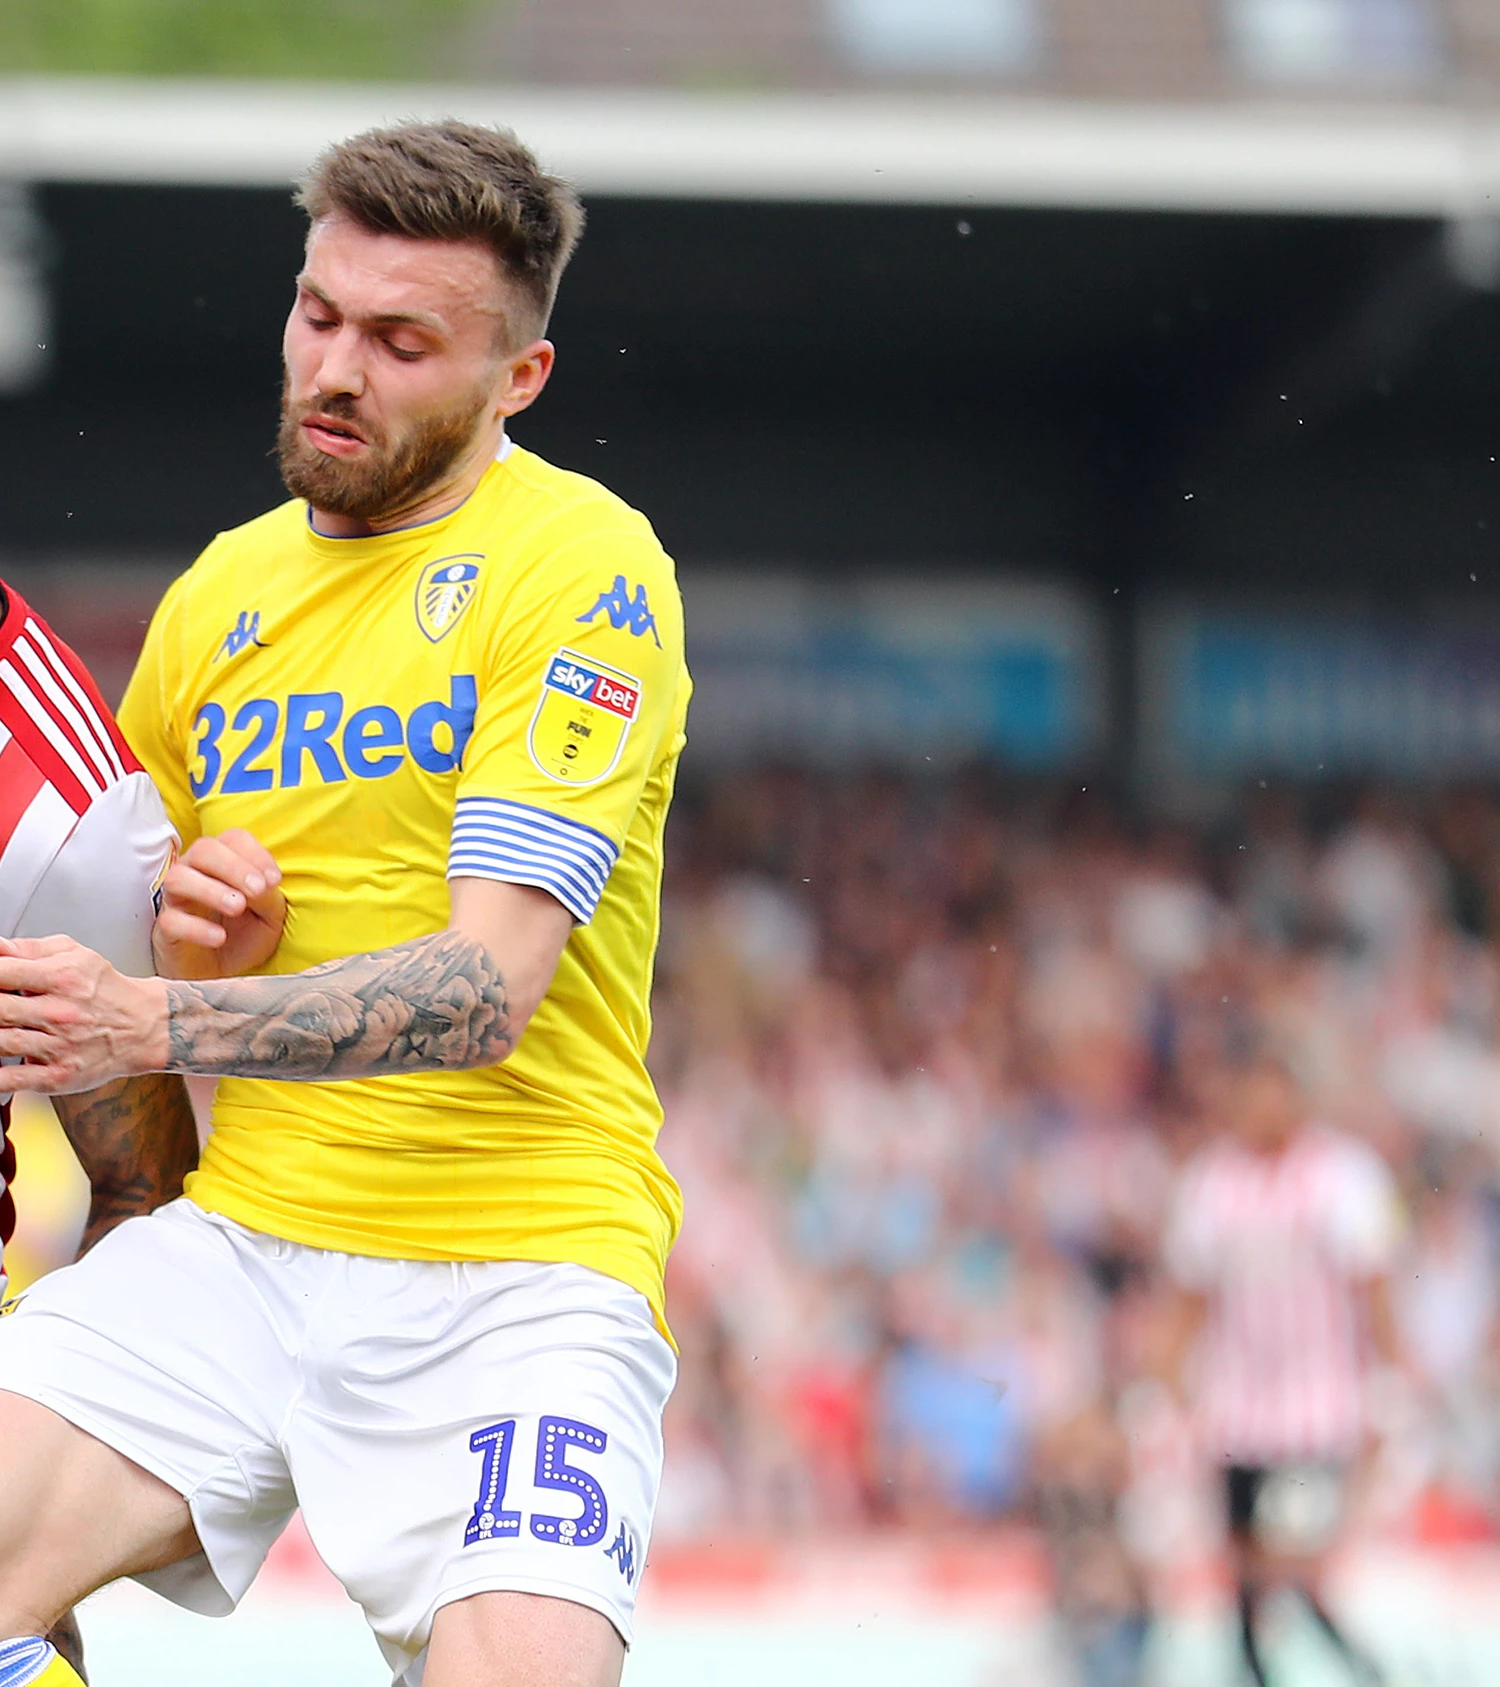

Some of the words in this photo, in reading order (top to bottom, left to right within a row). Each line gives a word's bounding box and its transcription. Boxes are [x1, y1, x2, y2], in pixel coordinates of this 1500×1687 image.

[551, 665, 595, 695] sky
[595, 678, 635, 712] bet
[189, 674, 478, 799] 32Red
[463, 1415, 608, 1548] 15
[479, 1530, 493, 1539] EFL
[558, 1535, 575, 1546] EFL
